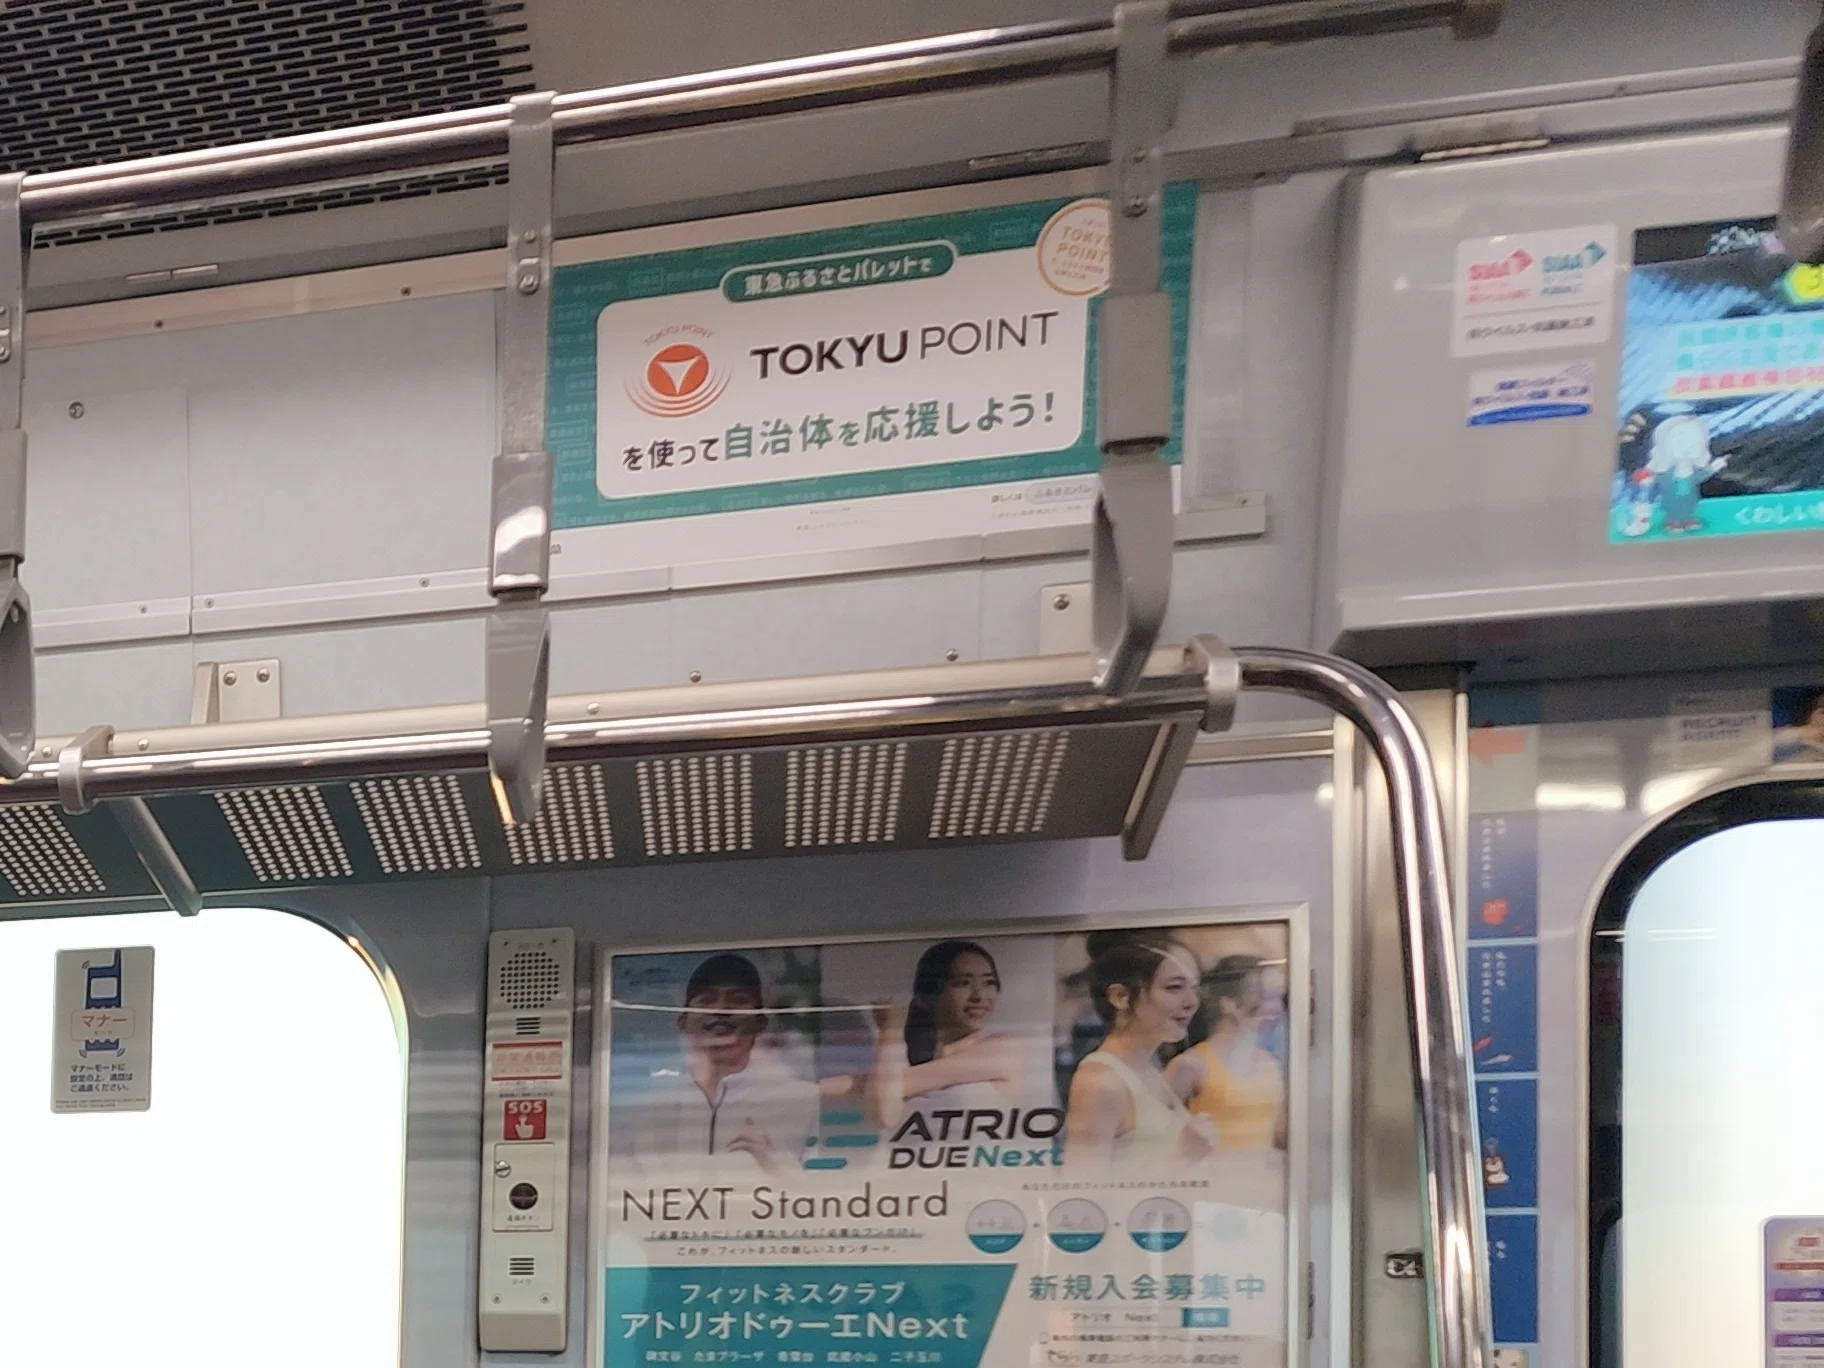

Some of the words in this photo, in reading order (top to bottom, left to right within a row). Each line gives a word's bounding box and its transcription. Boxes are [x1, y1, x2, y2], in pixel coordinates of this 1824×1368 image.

[743, 255, 933, 297] 東急ふるさとパレットで
[750, 329, 910, 380] TOKYU
[920, 309, 1060, 360] POINT
[622, 390, 1056, 472] を使って自治体を応援しよう！
[81, 1014, 127, 1028] マナー
[507, 1101, 545, 1115] SOS
[889, 1107, 1067, 1142] ATRIO
[622, 1187, 734, 1222] NEXT
[751, 1180, 948, 1220] Standard
[679, 1282, 906, 1305] フィットネスクラブ
[1028, 1273, 1266, 1302] 新規入会募集中
[620, 1311, 969, 1340] アトリオドゥーエNext
